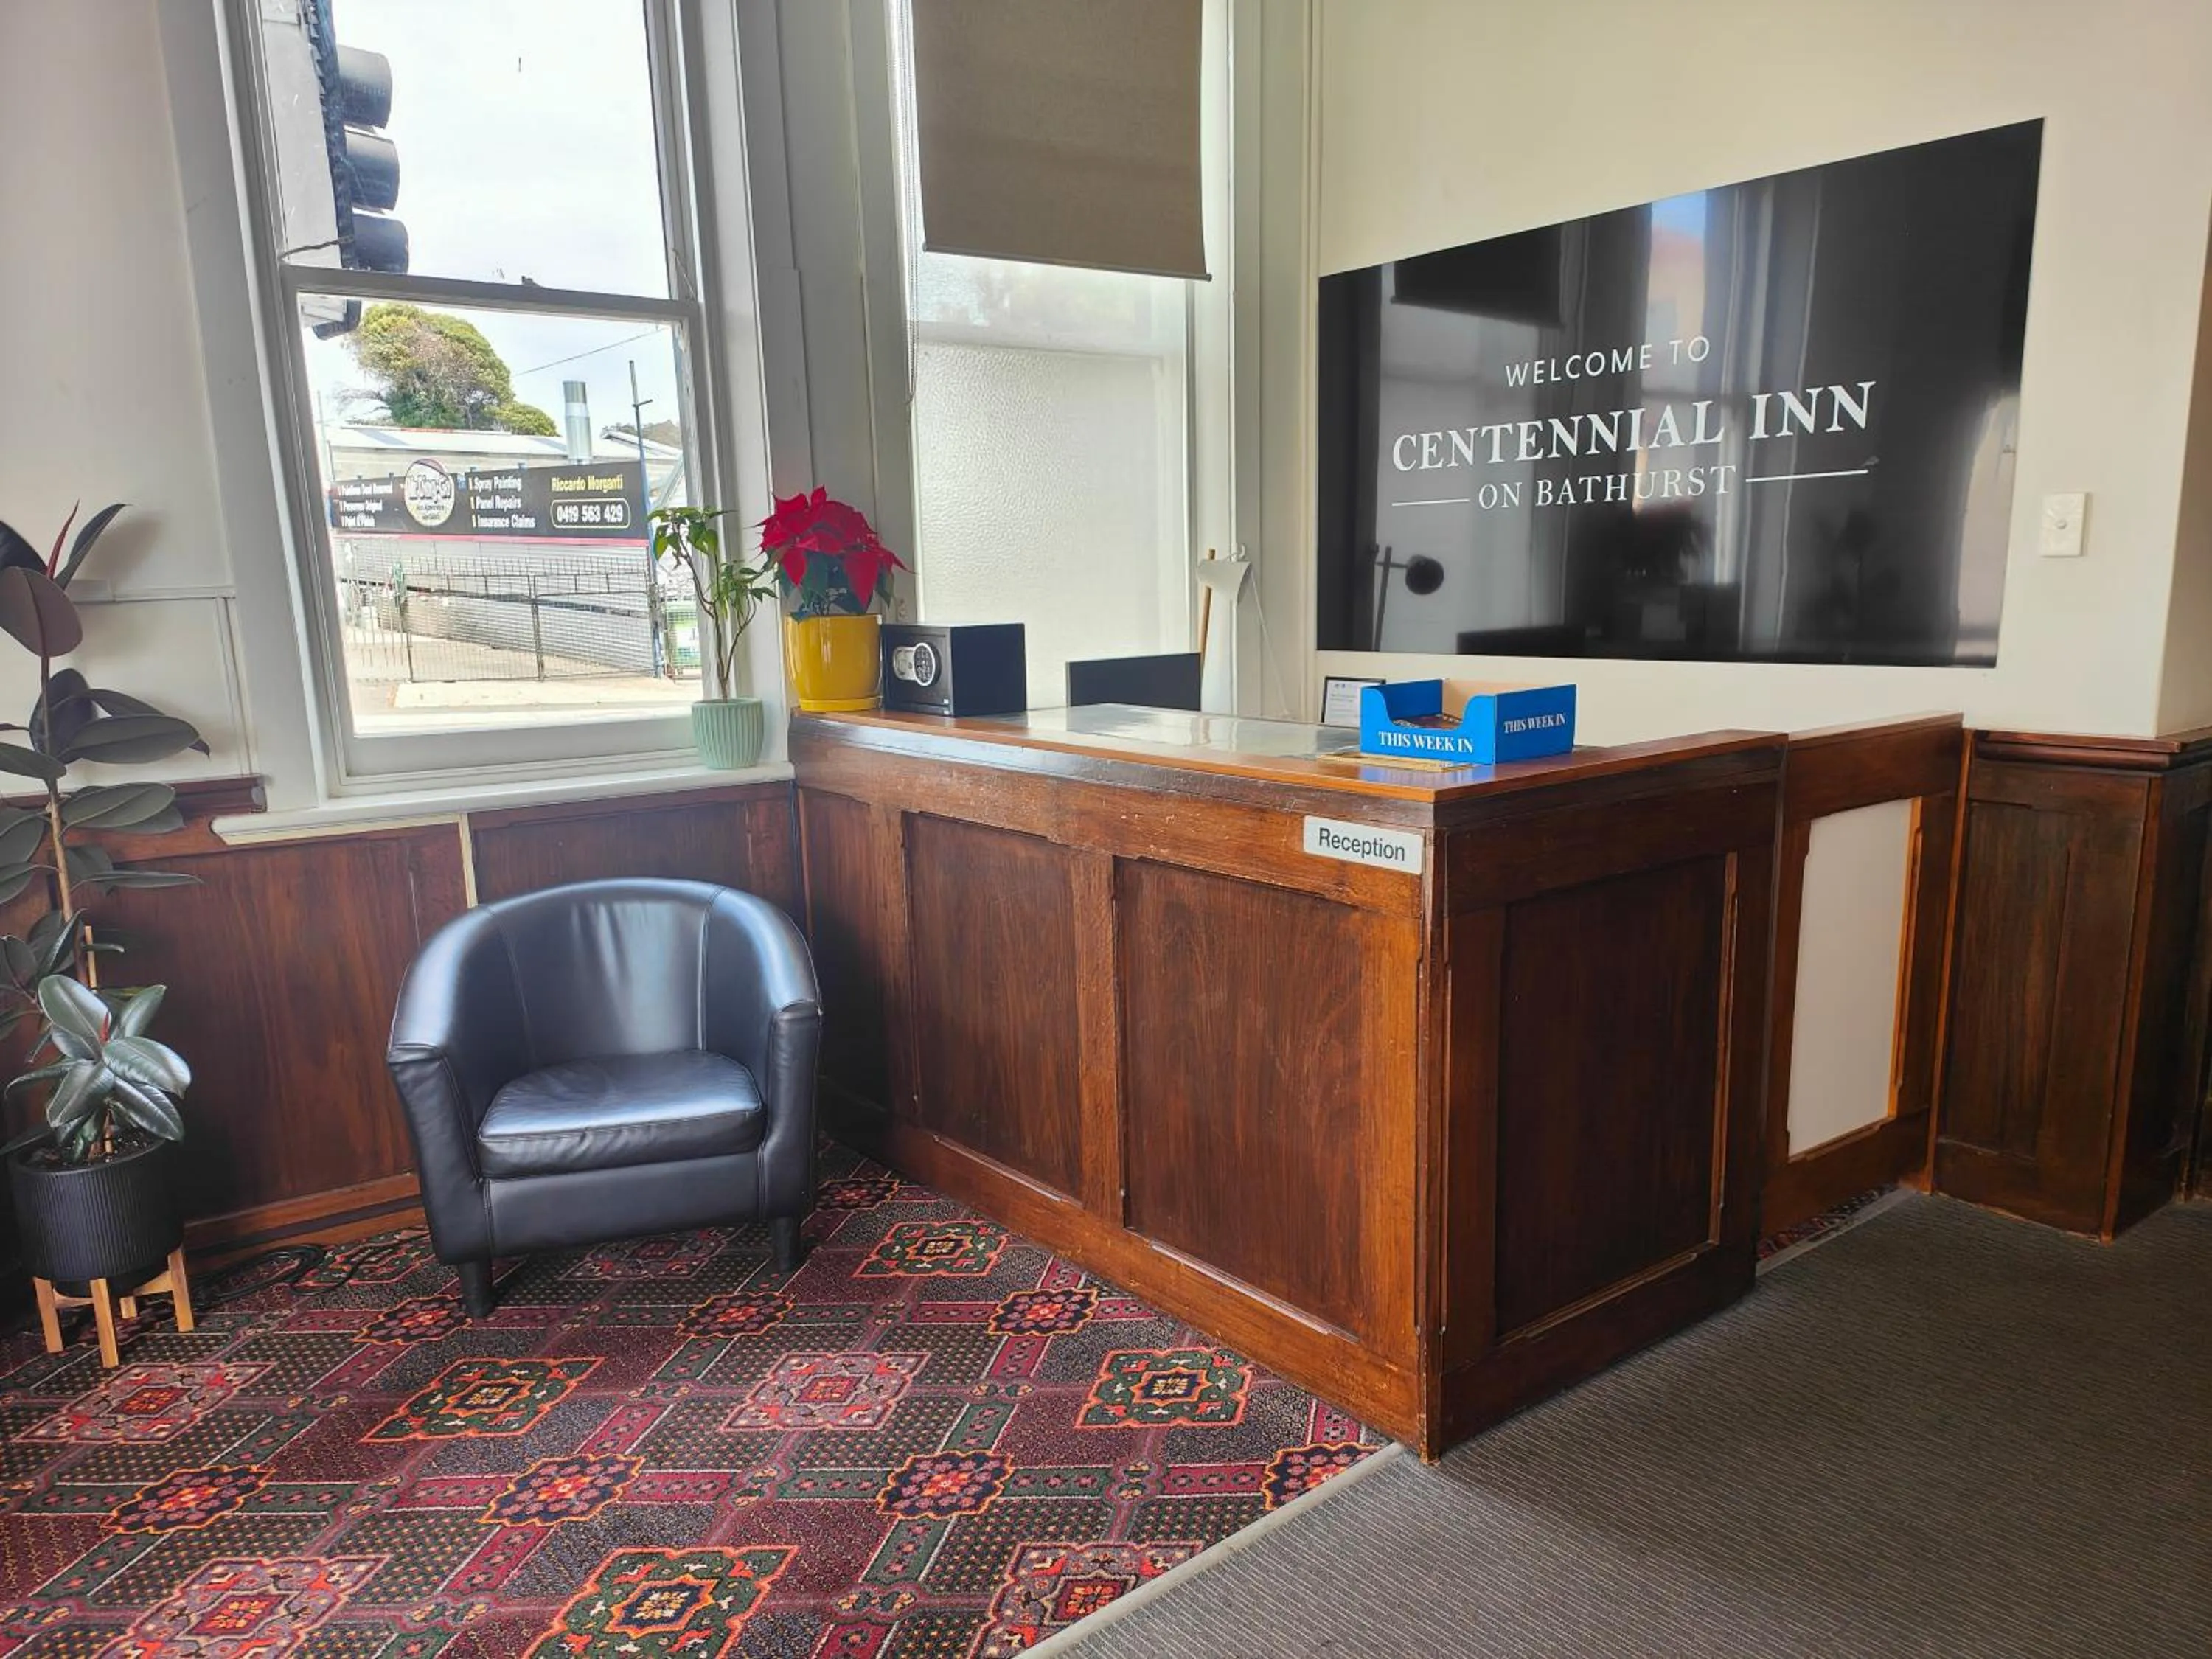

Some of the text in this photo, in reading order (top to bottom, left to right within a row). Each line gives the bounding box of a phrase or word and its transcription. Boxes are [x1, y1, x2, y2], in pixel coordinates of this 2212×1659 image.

[1505, 335, 1710, 387] WELCOME TO
[1392, 380, 1877, 472] CENTENNIAL INN
[474, 476, 522, 493] Spray Painting
[551, 473, 623, 493] Riccardo Morganti
[1478, 465, 1737, 510] ON BATHURST
[476, 495, 521, 512] Panel Repairs
[557, 504, 624, 523] 0419 563 429
[477, 514, 536, 529] Insurance Claims
[1503, 712, 1567, 734] THIS WEEK IN
[1377, 731, 1474, 754] THIS WEEK IN
[1318, 827, 1405, 862] Reception
